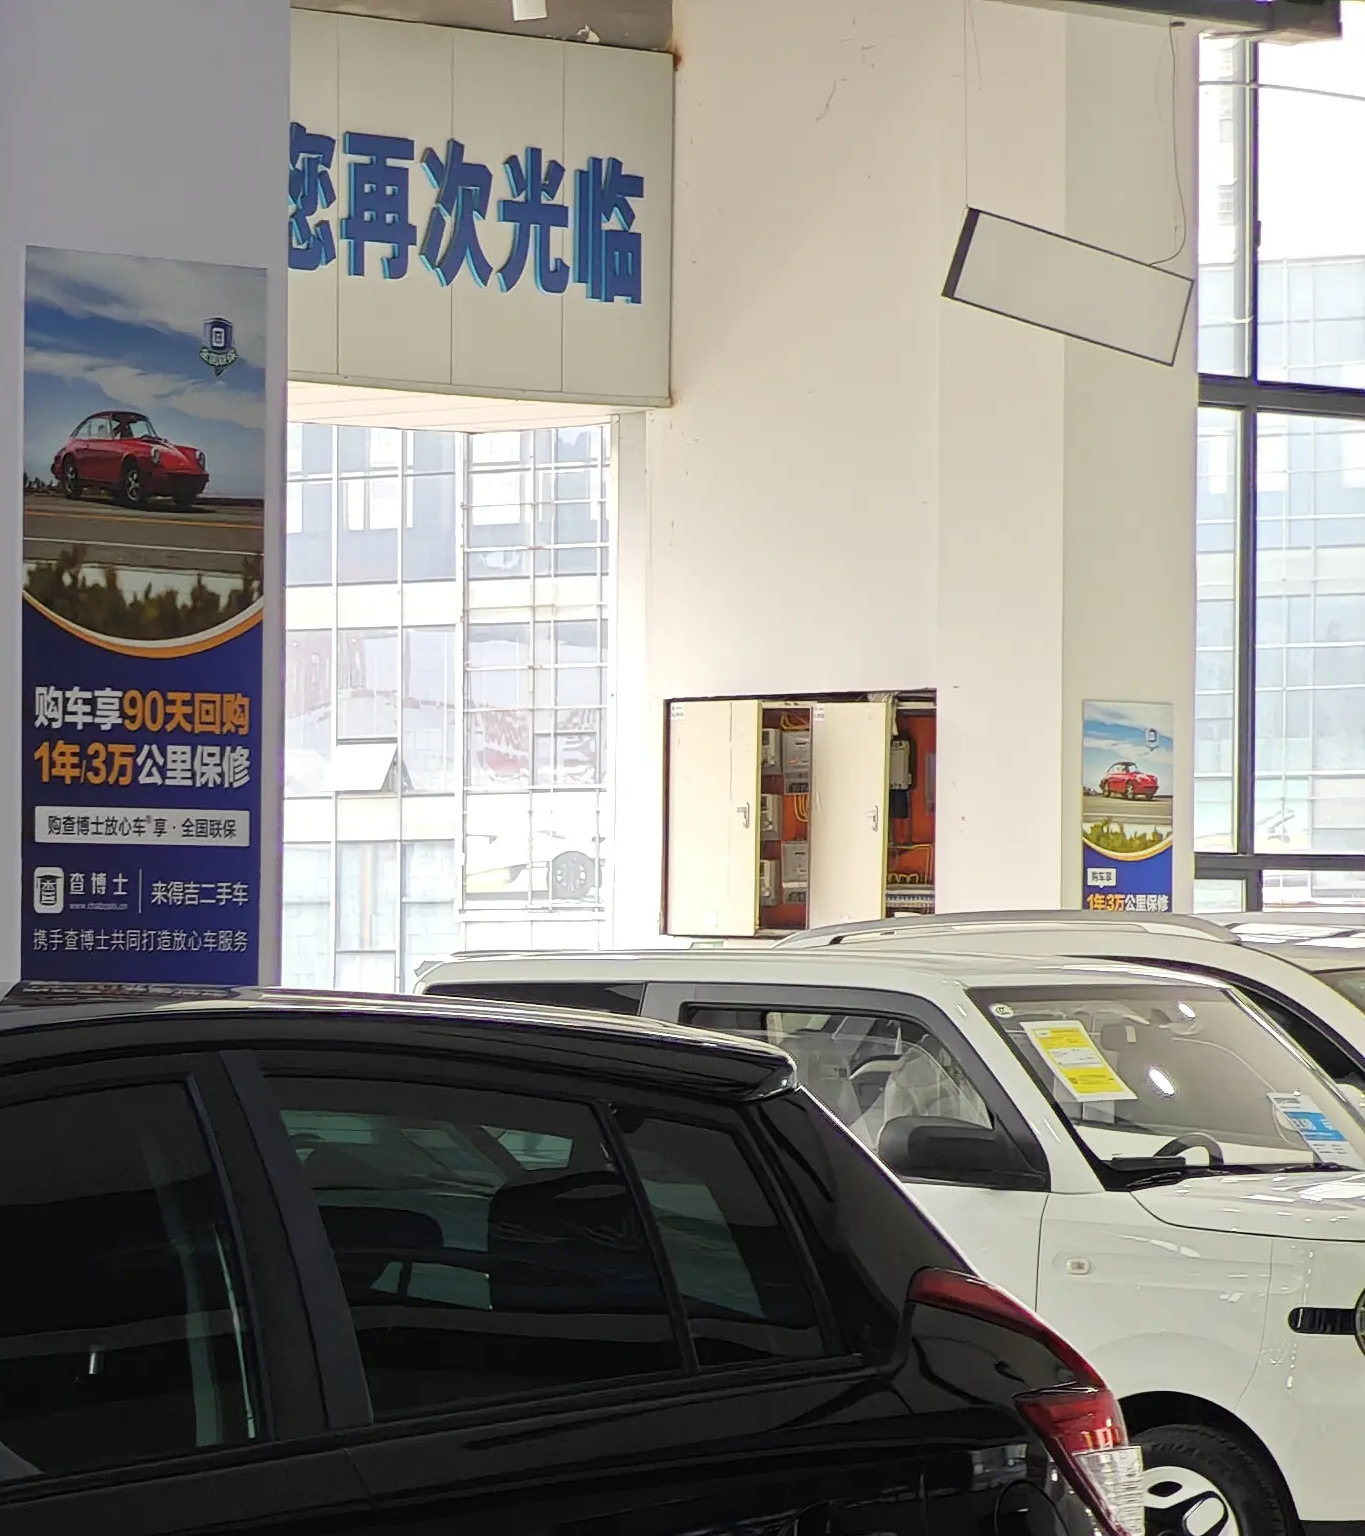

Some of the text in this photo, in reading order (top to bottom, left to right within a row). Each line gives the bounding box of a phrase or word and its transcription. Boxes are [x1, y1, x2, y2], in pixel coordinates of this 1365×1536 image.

[33, 686, 251, 736] 购车享90天回购
